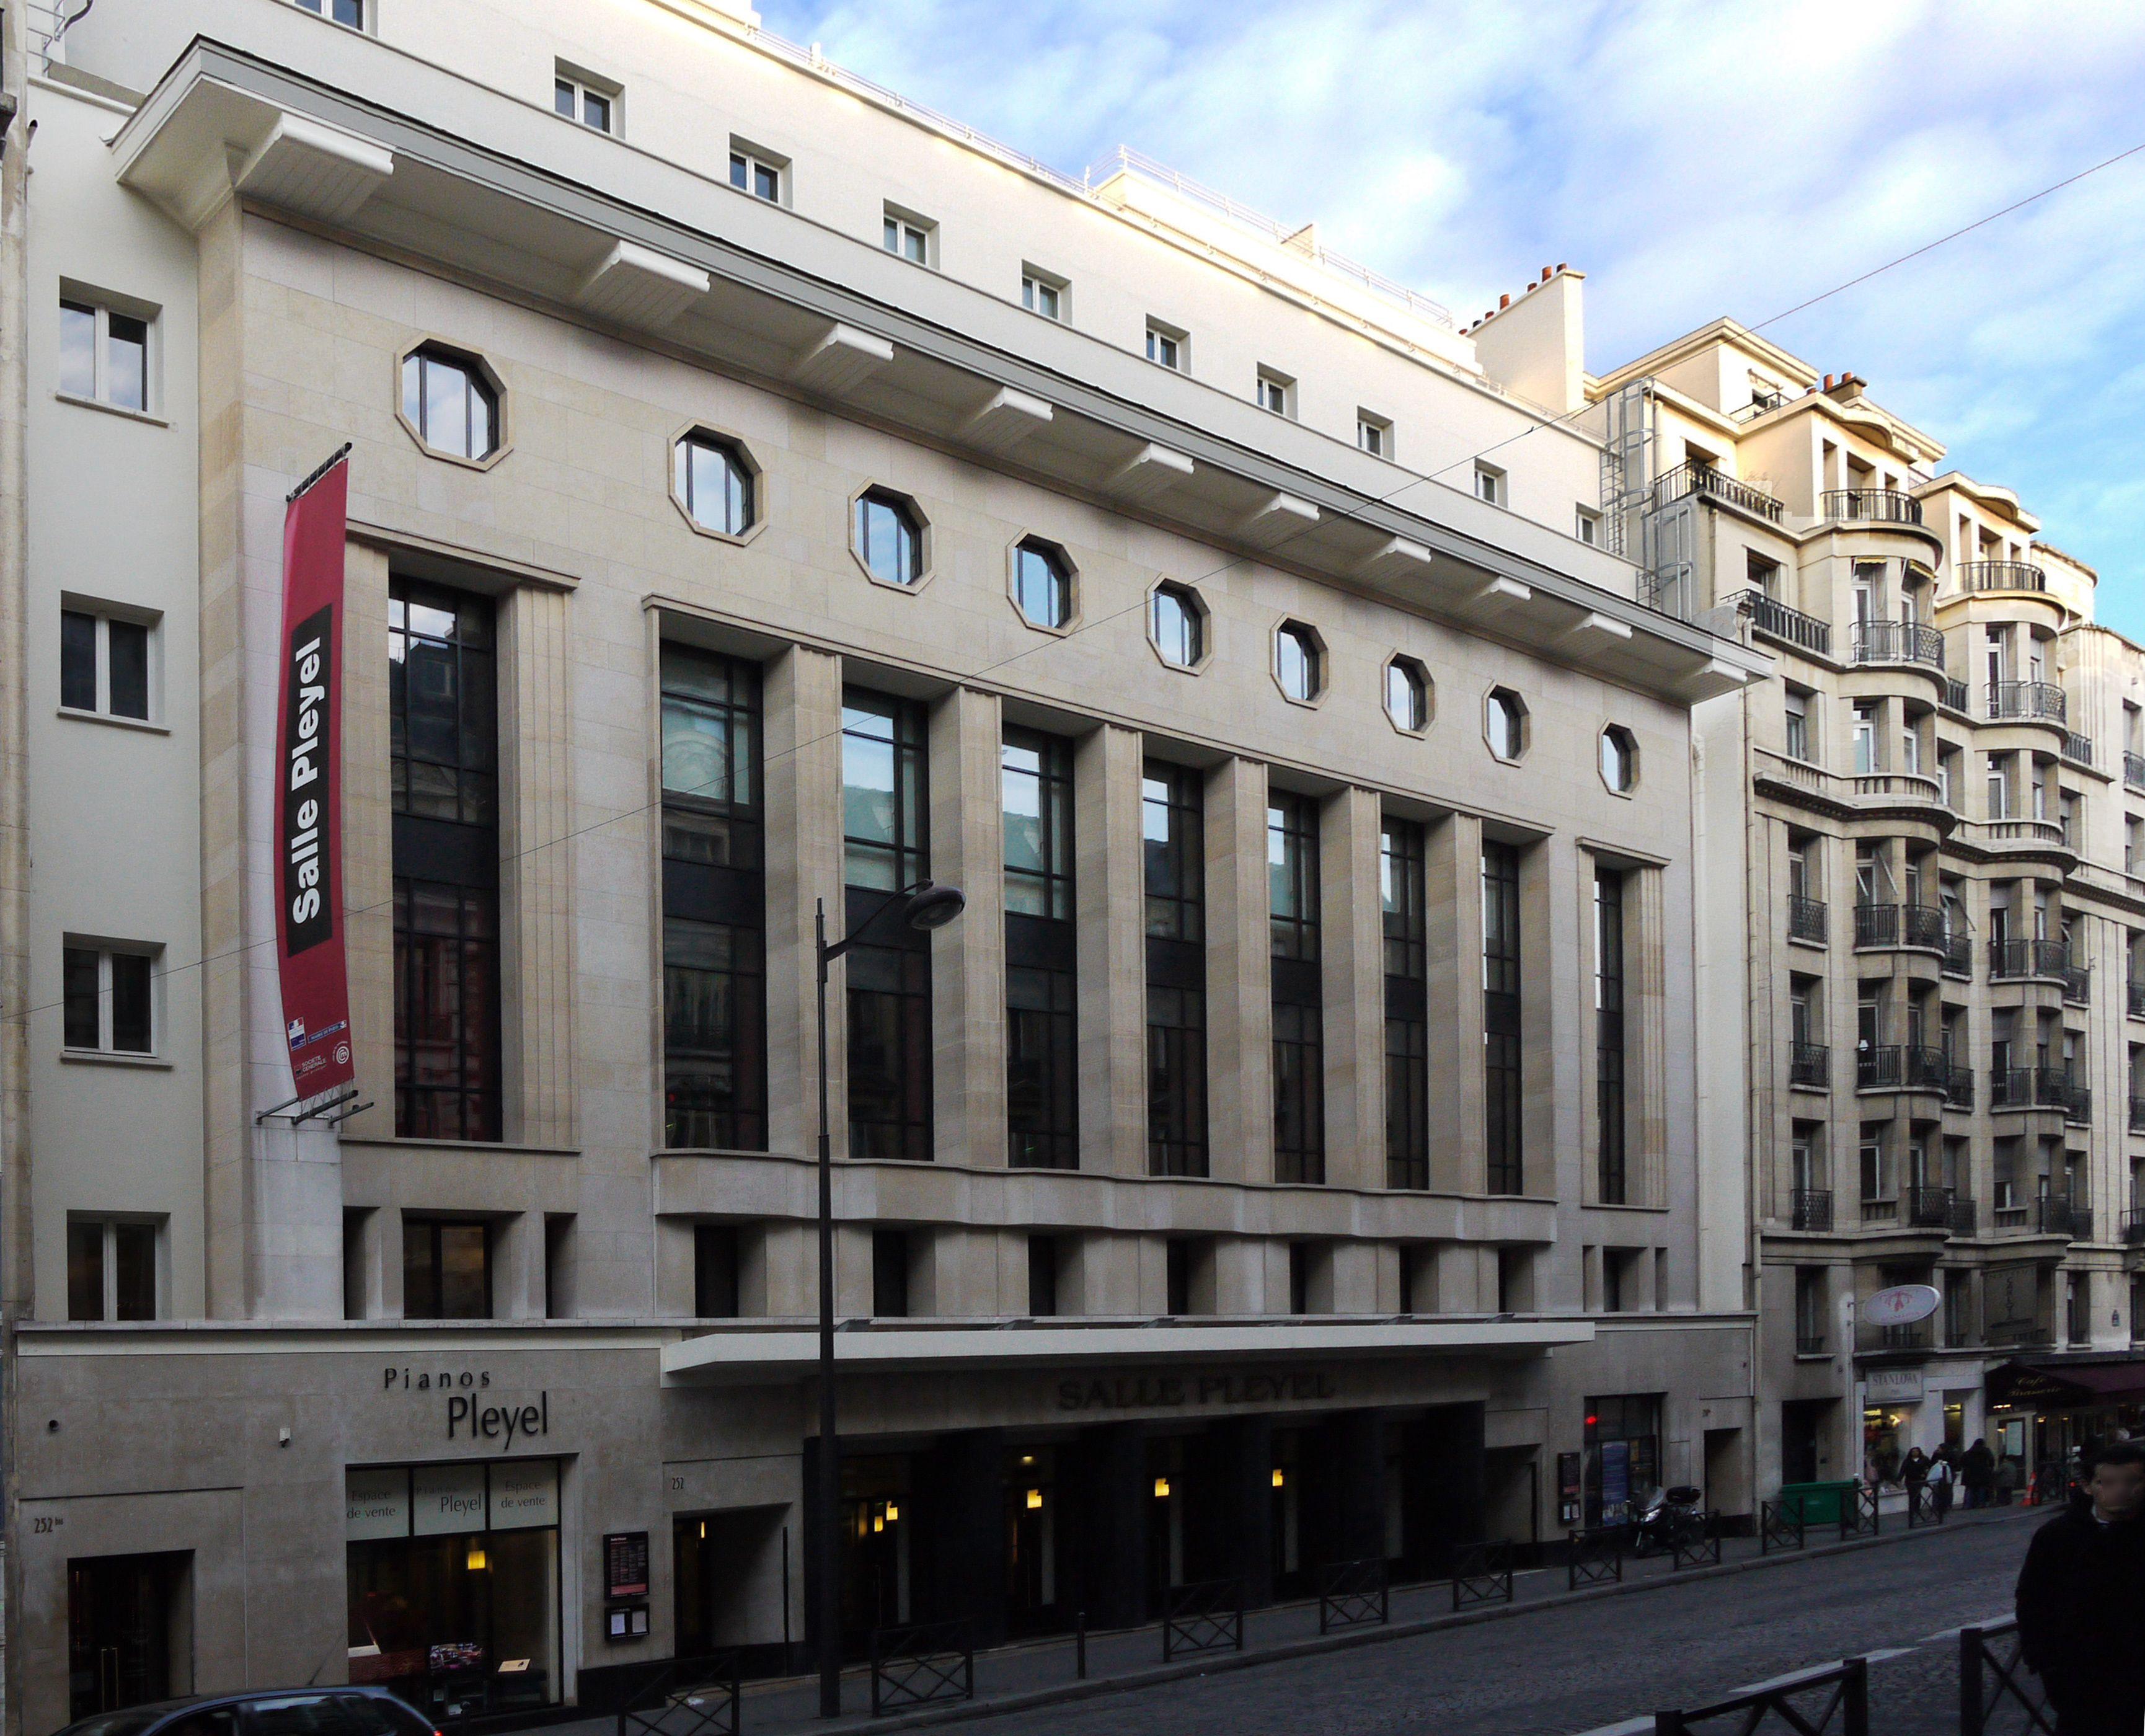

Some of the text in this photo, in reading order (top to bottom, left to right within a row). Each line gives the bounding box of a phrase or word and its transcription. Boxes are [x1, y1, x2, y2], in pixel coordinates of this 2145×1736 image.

[291, 637, 325, 924] Salle Pleyel
[384, 1368, 490, 1389] Pianos
[1058, 1372, 1334, 1410] SALLE PLEYEL
[448, 1390, 548, 1450] Pleyel
[505, 1480, 541, 1493] Espace
[671, 1477, 684, 1490] 252
[352, 1490, 392, 1504] Espace
[441, 1494, 482, 1517] Pleyel
[501, 1496, 546, 1508] de vente
[347, 1507, 396, 1519] de vente
[34, 1517, 53, 1534] 252
